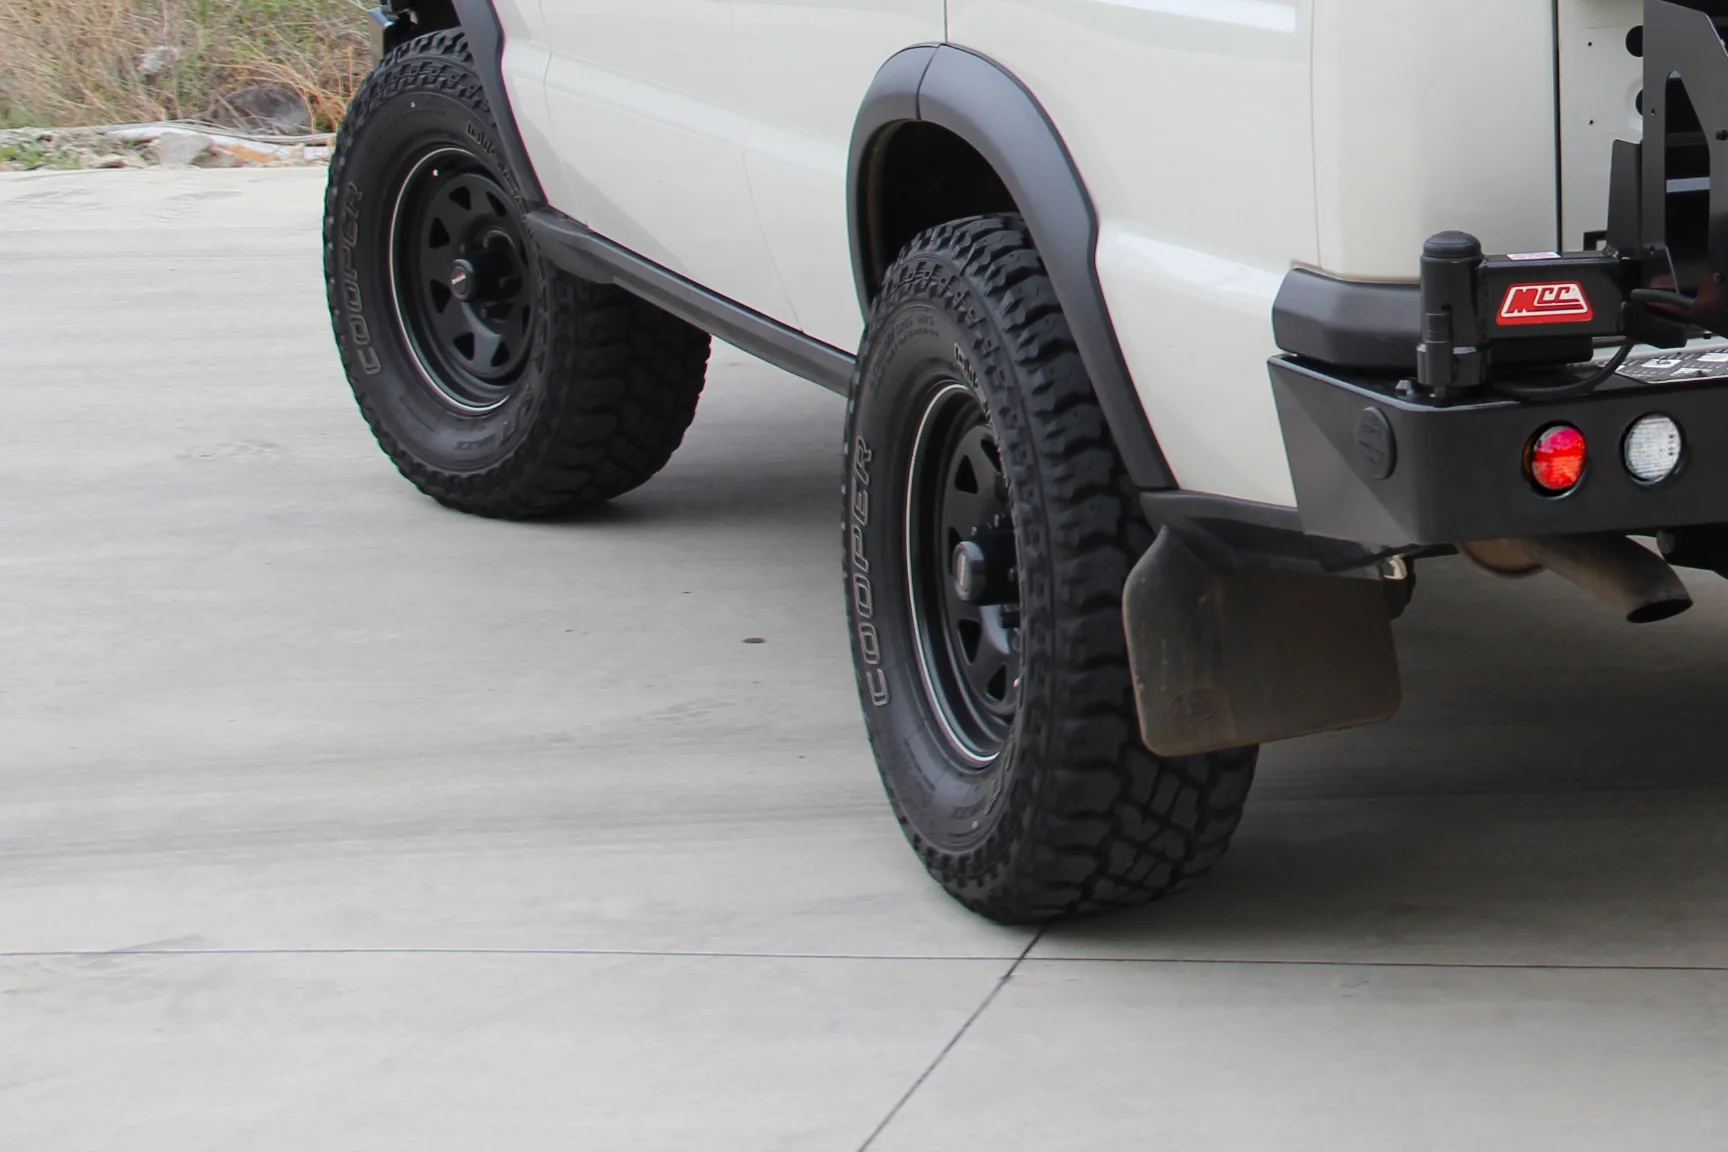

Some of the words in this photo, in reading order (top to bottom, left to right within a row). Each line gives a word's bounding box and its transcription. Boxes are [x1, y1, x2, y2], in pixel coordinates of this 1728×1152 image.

[342, 180, 382, 376] COOPER
[1503, 285, 1586, 315] MCC
[851, 434, 890, 707] COOPER
